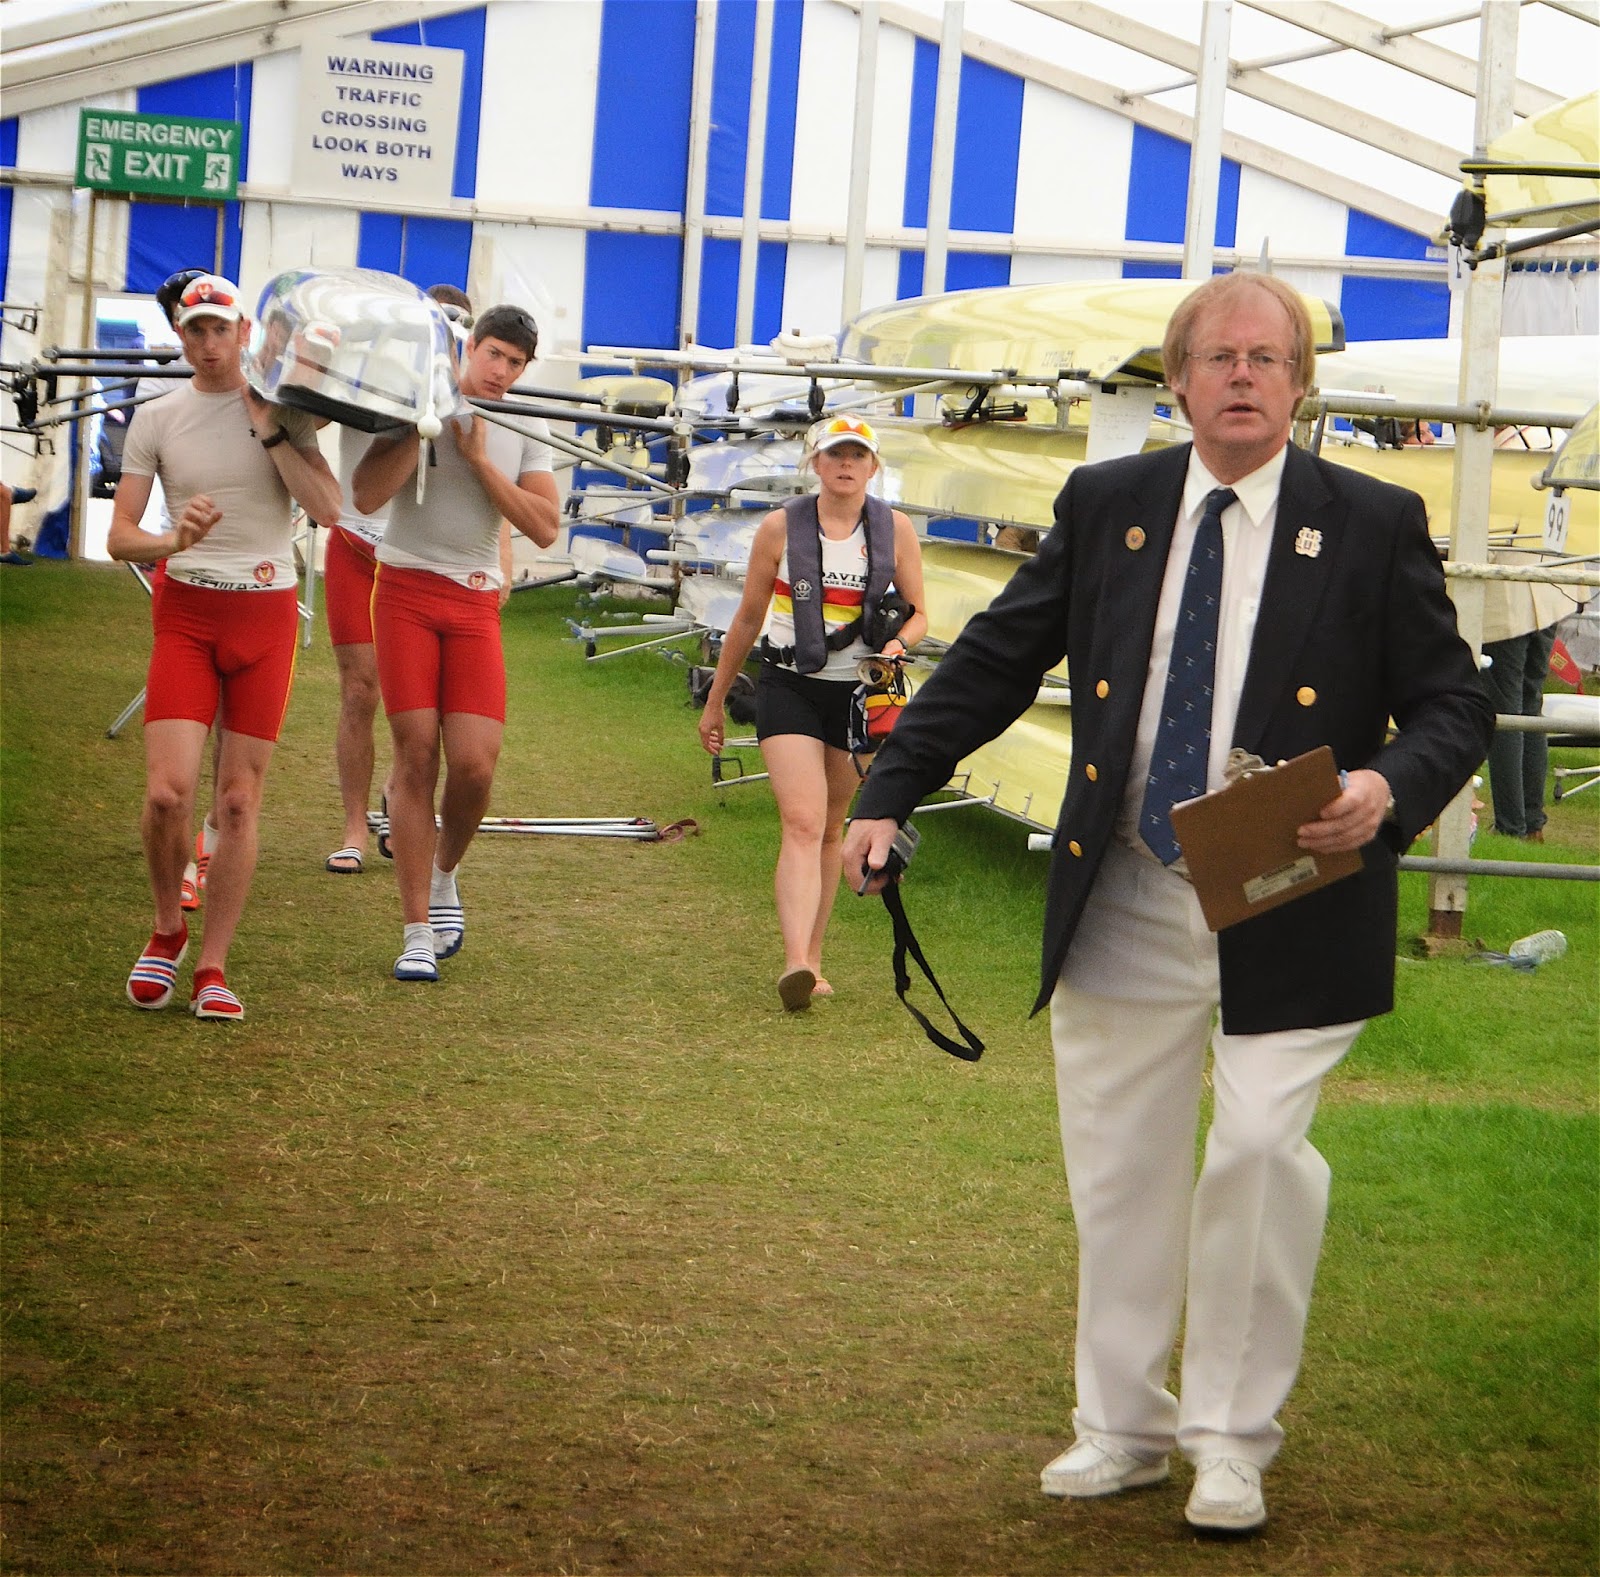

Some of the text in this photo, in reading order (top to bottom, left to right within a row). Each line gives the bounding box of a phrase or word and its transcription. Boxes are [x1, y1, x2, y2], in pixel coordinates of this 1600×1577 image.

[327, 56, 433, 80] WARNING
[336, 86, 422, 107] TRAFFIC
[86, 118, 232, 149] EMERGENCY
[321, 110, 427, 133] CROSSING
[312, 135, 431, 159] LOOK BOTH
[124, 150, 190, 181] EXIT
[341, 163, 398, 181] WAYS
[1548, 503, 1564, 541] 99
[823, 572, 868, 583] AVIE
